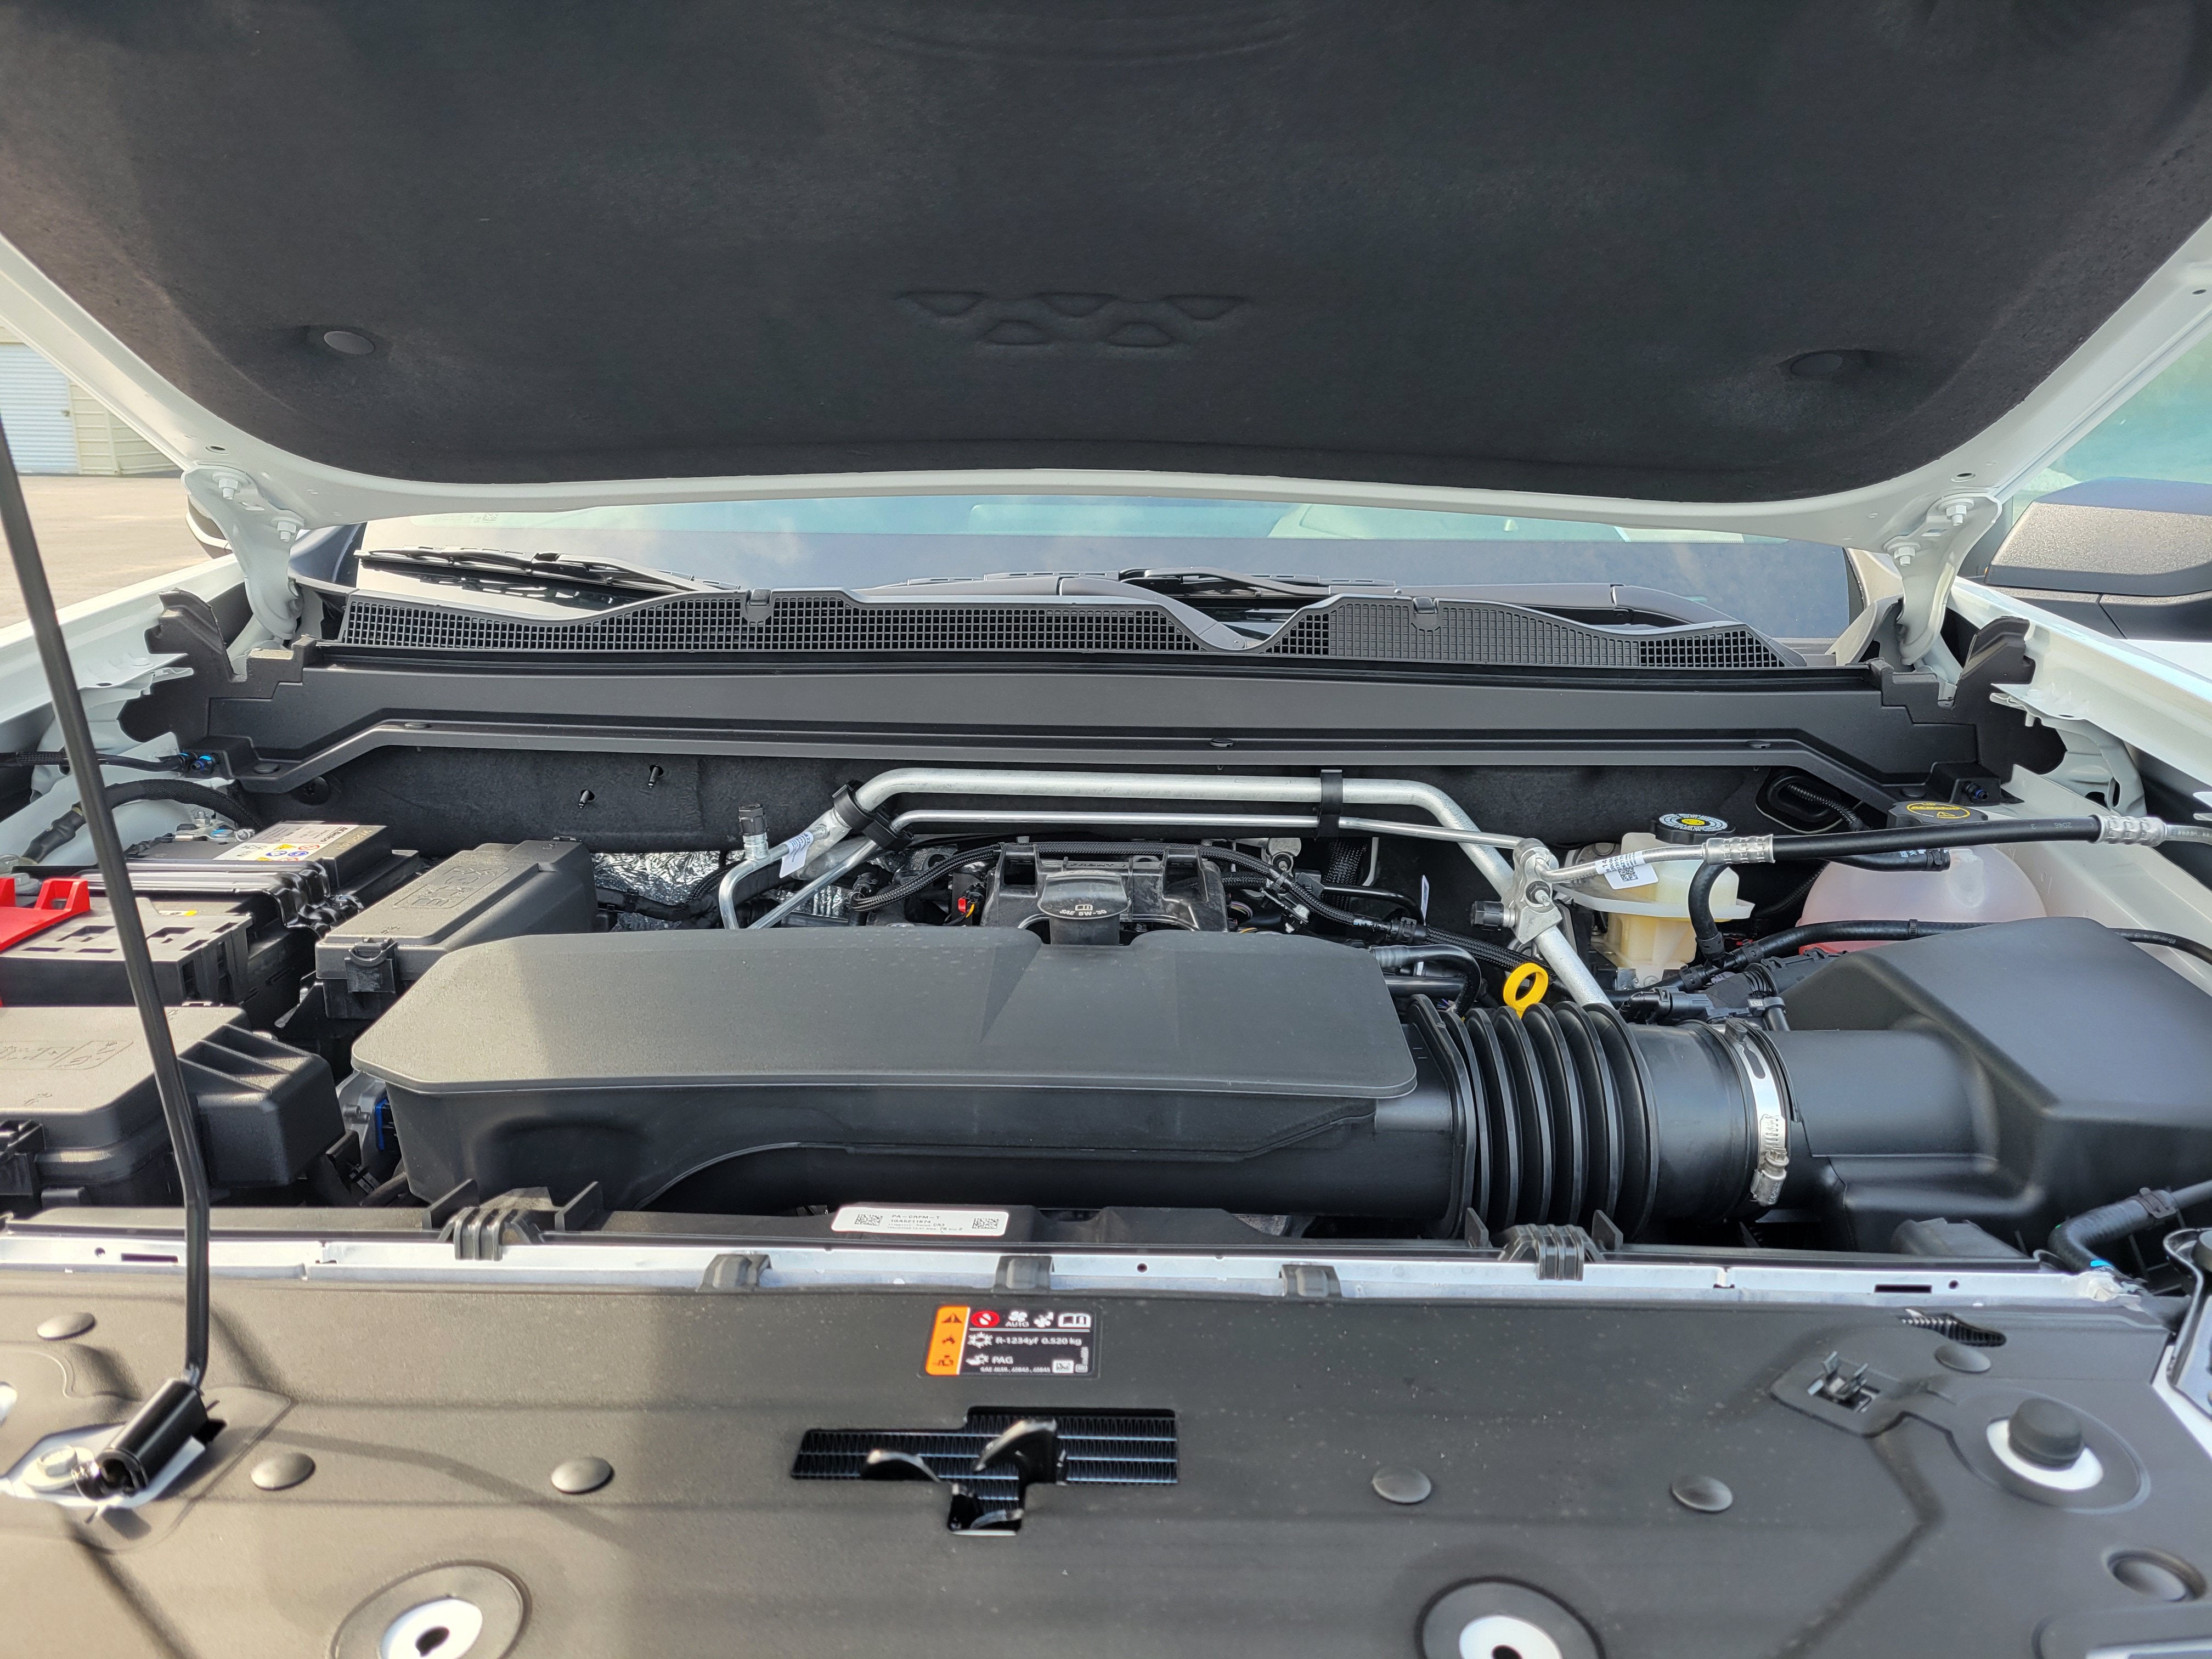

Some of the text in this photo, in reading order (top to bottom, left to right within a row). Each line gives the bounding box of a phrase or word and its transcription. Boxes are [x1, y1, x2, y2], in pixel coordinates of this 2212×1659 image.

[320, 827, 348, 843] ACDelco
[995, 1337, 1039, 1345] R-1234yf
[1069, 1337, 1082, 1346] kg
